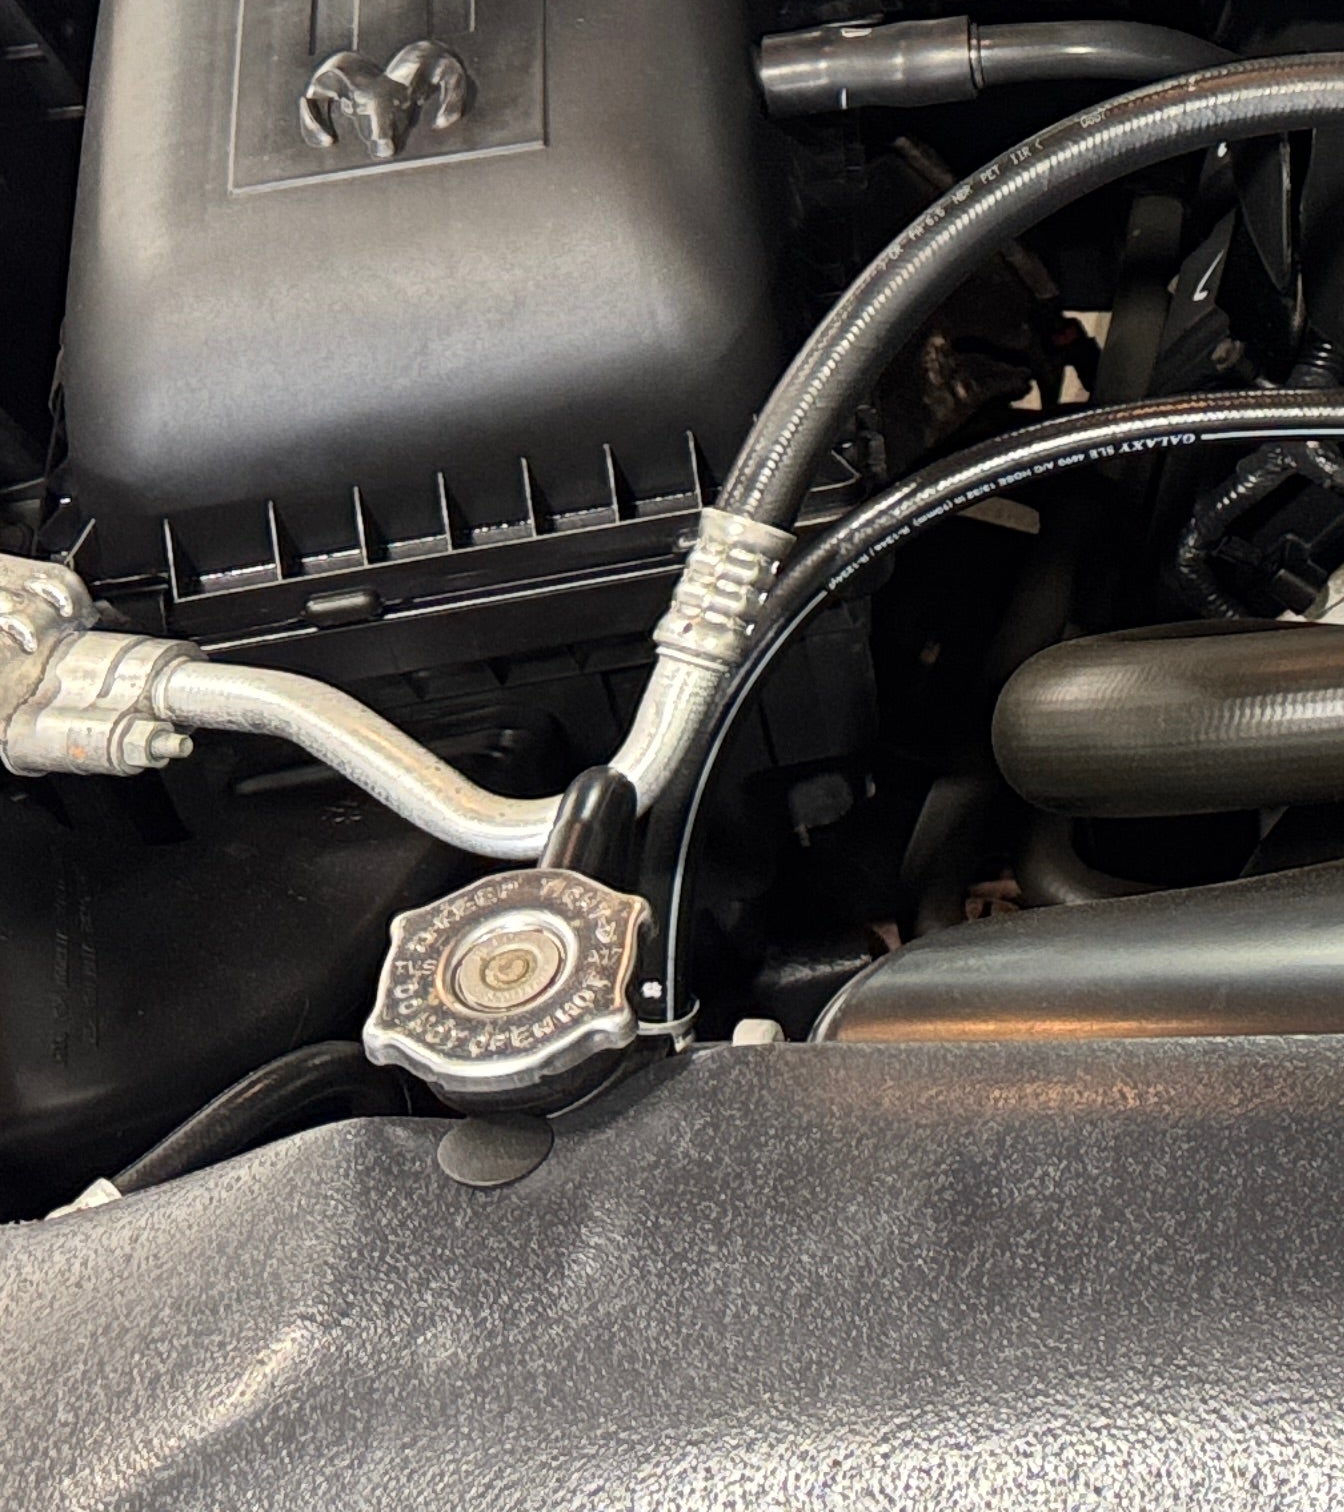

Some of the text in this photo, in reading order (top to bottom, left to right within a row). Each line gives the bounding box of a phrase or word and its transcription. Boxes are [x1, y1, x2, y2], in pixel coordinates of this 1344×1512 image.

[979, 164, 1003, 185] PET
[1118, 432, 1196, 454] GALAXY
[997, 468, 1032, 487] HOSE
[1033, 461, 1055, 475] A/C
